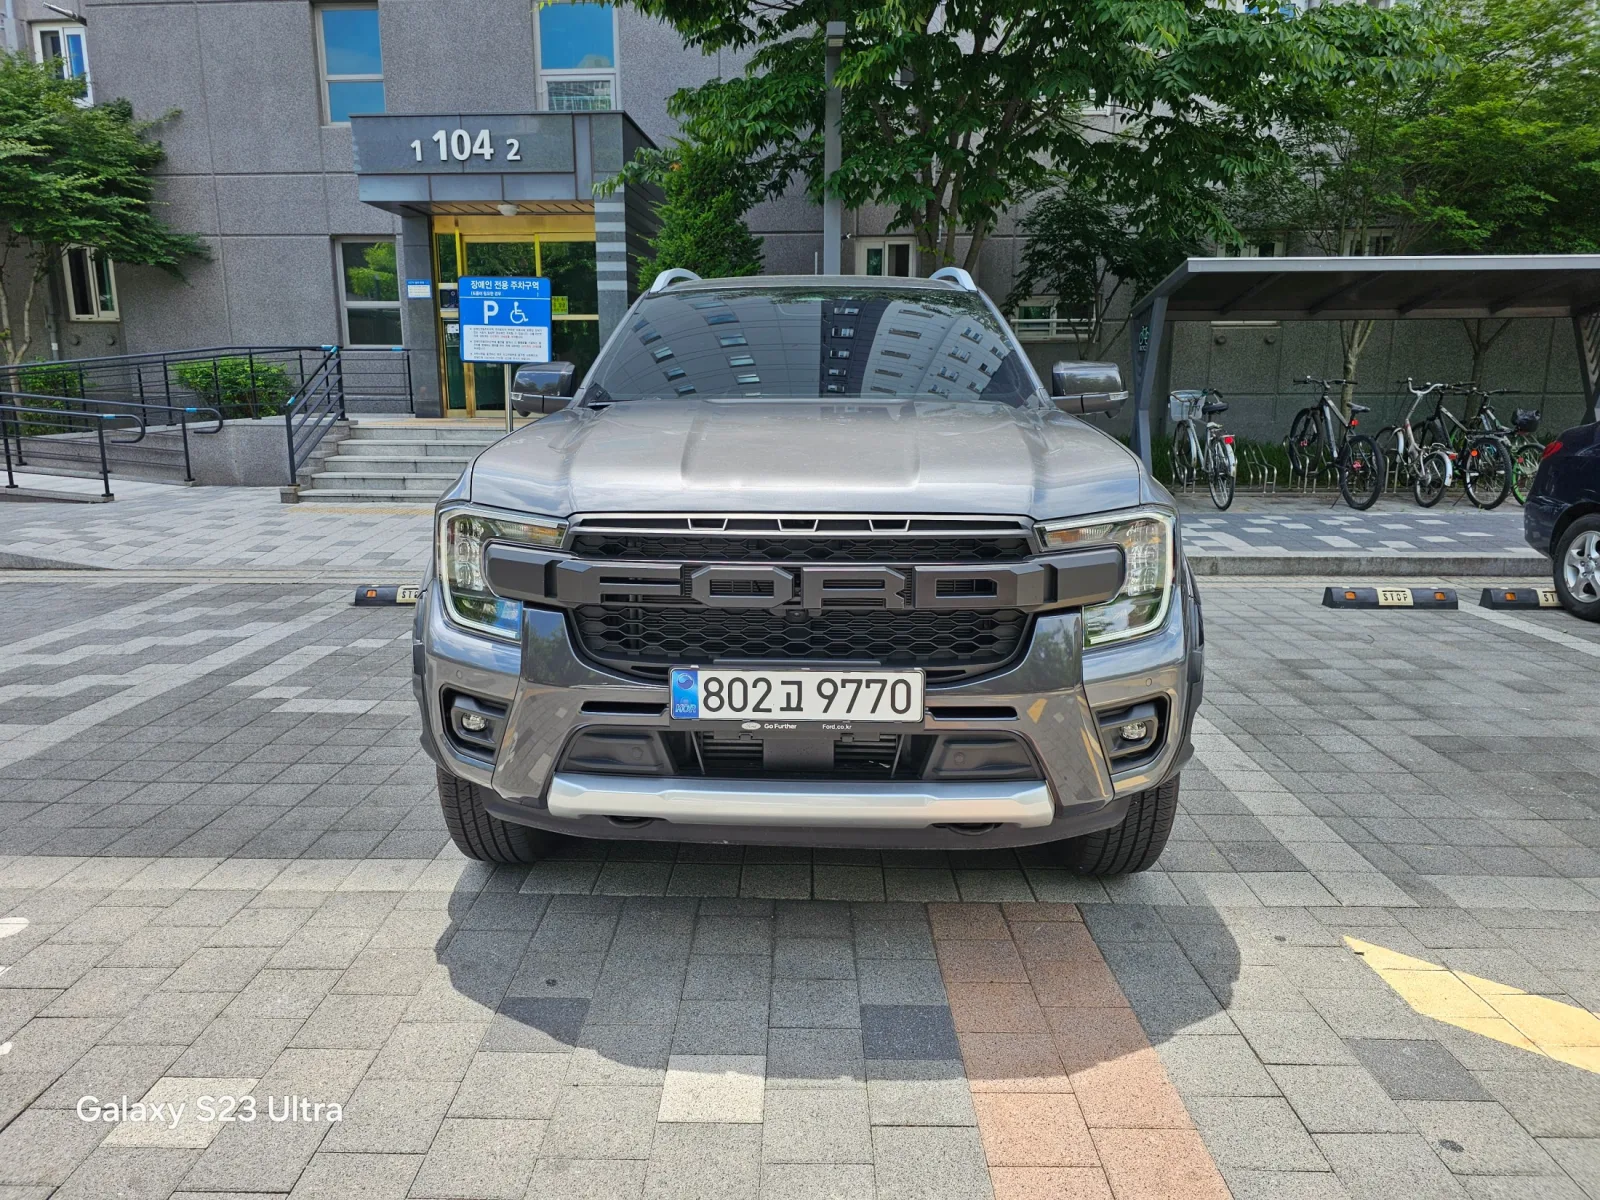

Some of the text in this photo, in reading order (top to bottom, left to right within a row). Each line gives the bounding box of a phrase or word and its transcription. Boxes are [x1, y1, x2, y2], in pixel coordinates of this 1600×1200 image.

[410, 129, 521, 162] 1 104 2
[470, 280, 540, 291] 장애인 전용 주차구역
[483, 300, 499, 325] P
[557, 562, 1044, 613] FORD
[1383, 592, 1408, 602] STOP
[1543, 593, 1555, 603] ST
[703, 676, 912, 715] 802고 9770
[675, 703, 697, 714] KOR
[822, 723, 852, 731] Ford.co.kr
